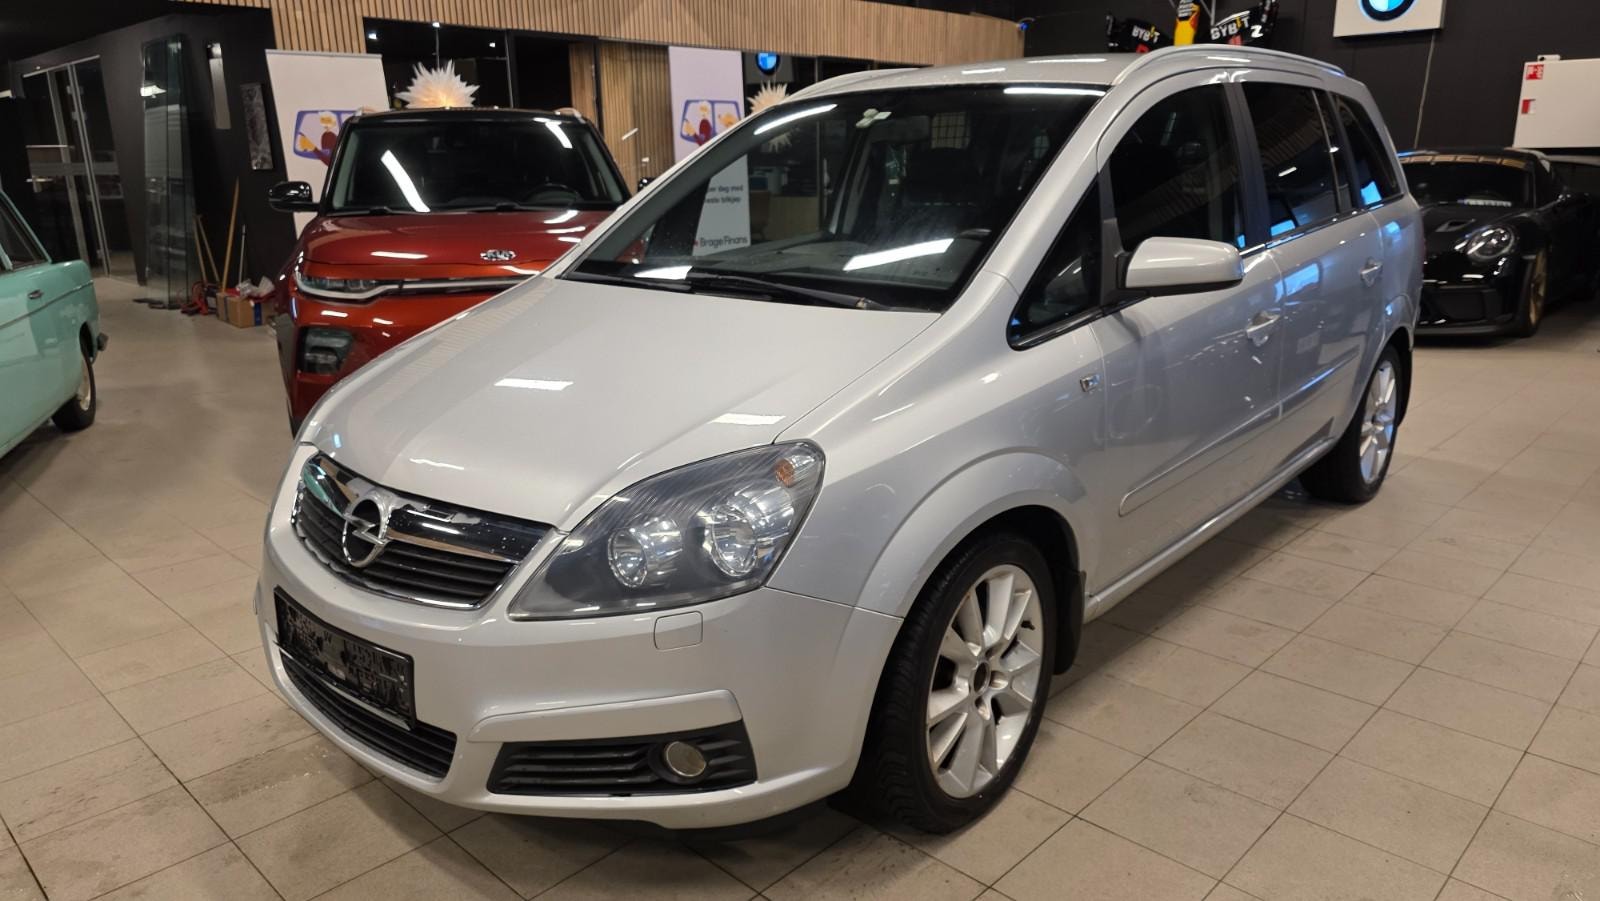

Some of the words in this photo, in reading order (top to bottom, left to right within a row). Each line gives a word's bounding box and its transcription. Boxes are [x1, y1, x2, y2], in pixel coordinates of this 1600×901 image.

[1210, 16, 1250, 40] BYBIT
[699, 237, 723, 249] Brage
[723, 235, 749, 246] Finans
